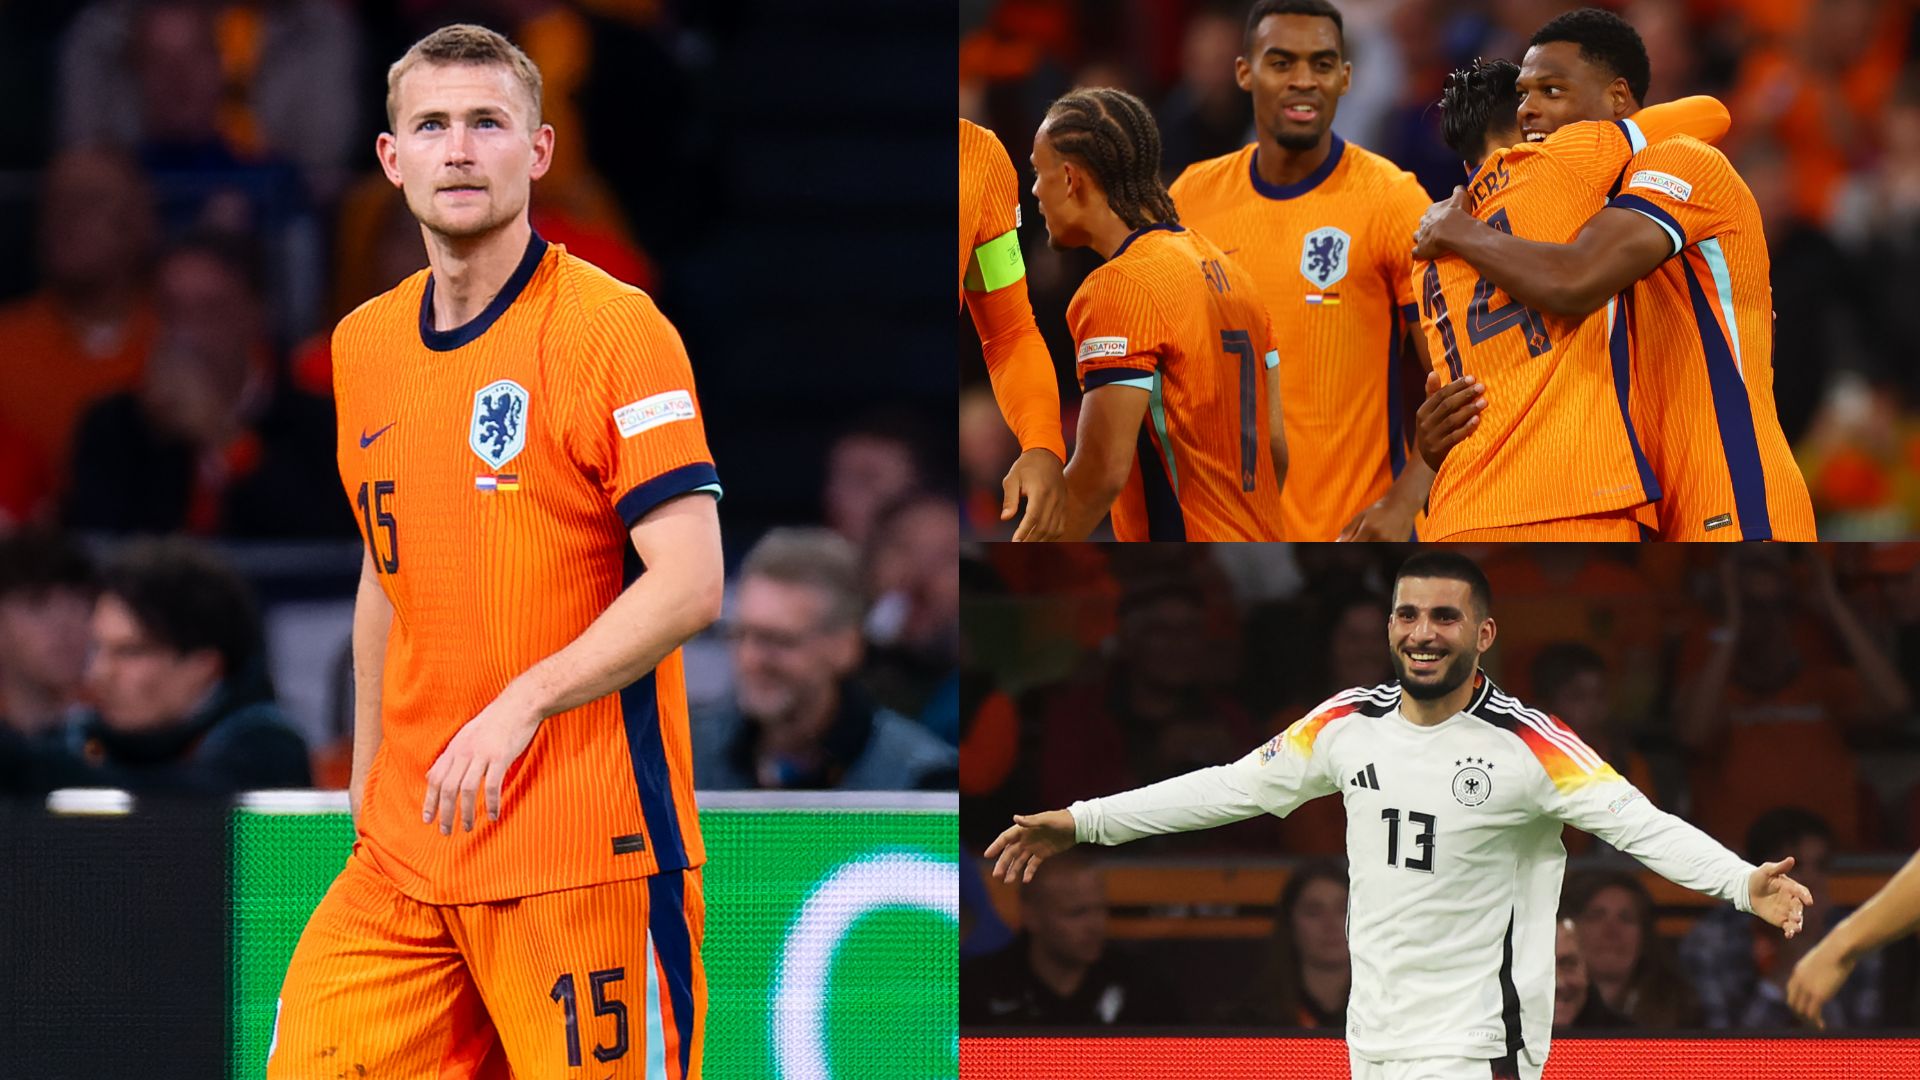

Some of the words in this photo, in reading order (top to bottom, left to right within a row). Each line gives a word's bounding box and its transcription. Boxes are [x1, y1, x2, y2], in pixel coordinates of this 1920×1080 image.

[1423, 207, 1552, 382] 14
[619, 399, 692, 428] FOUNDATION
[1220, 329, 1258, 492] 7
[358, 480, 399, 574] 15
[1381, 808, 1437, 874] 13
[550, 967, 629, 1067] 15
